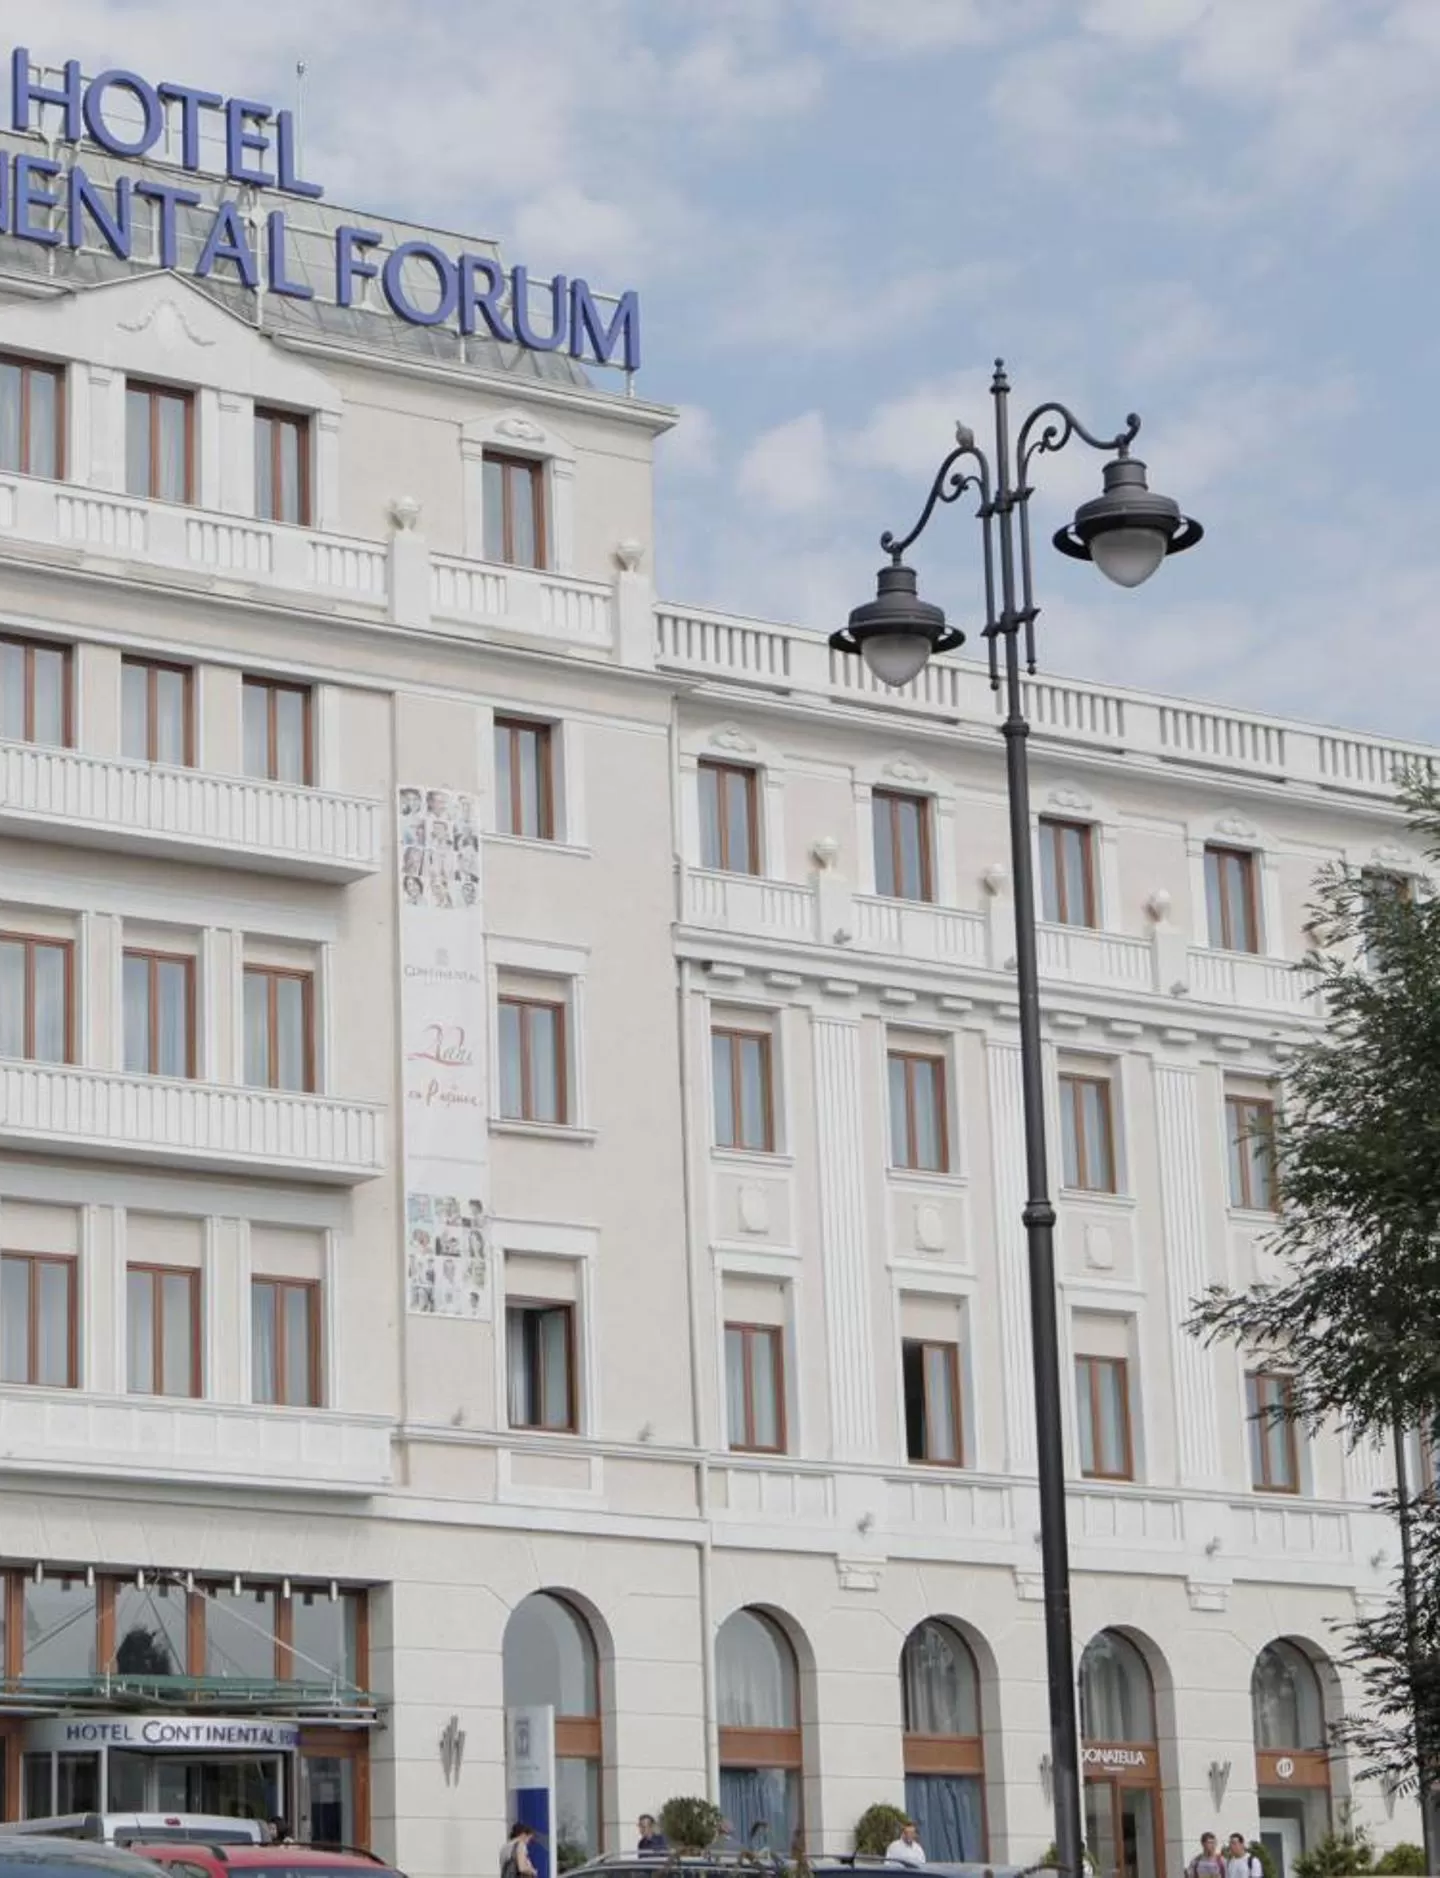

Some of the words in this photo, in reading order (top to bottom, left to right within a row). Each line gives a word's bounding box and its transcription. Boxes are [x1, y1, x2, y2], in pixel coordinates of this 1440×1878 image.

[11, 47, 324, 198] HOTEL
[336, 225, 641, 372] FORUM
[66, 1724, 134, 1742] HOTEL
[142, 1720, 275, 1744] CONTINENTAL
